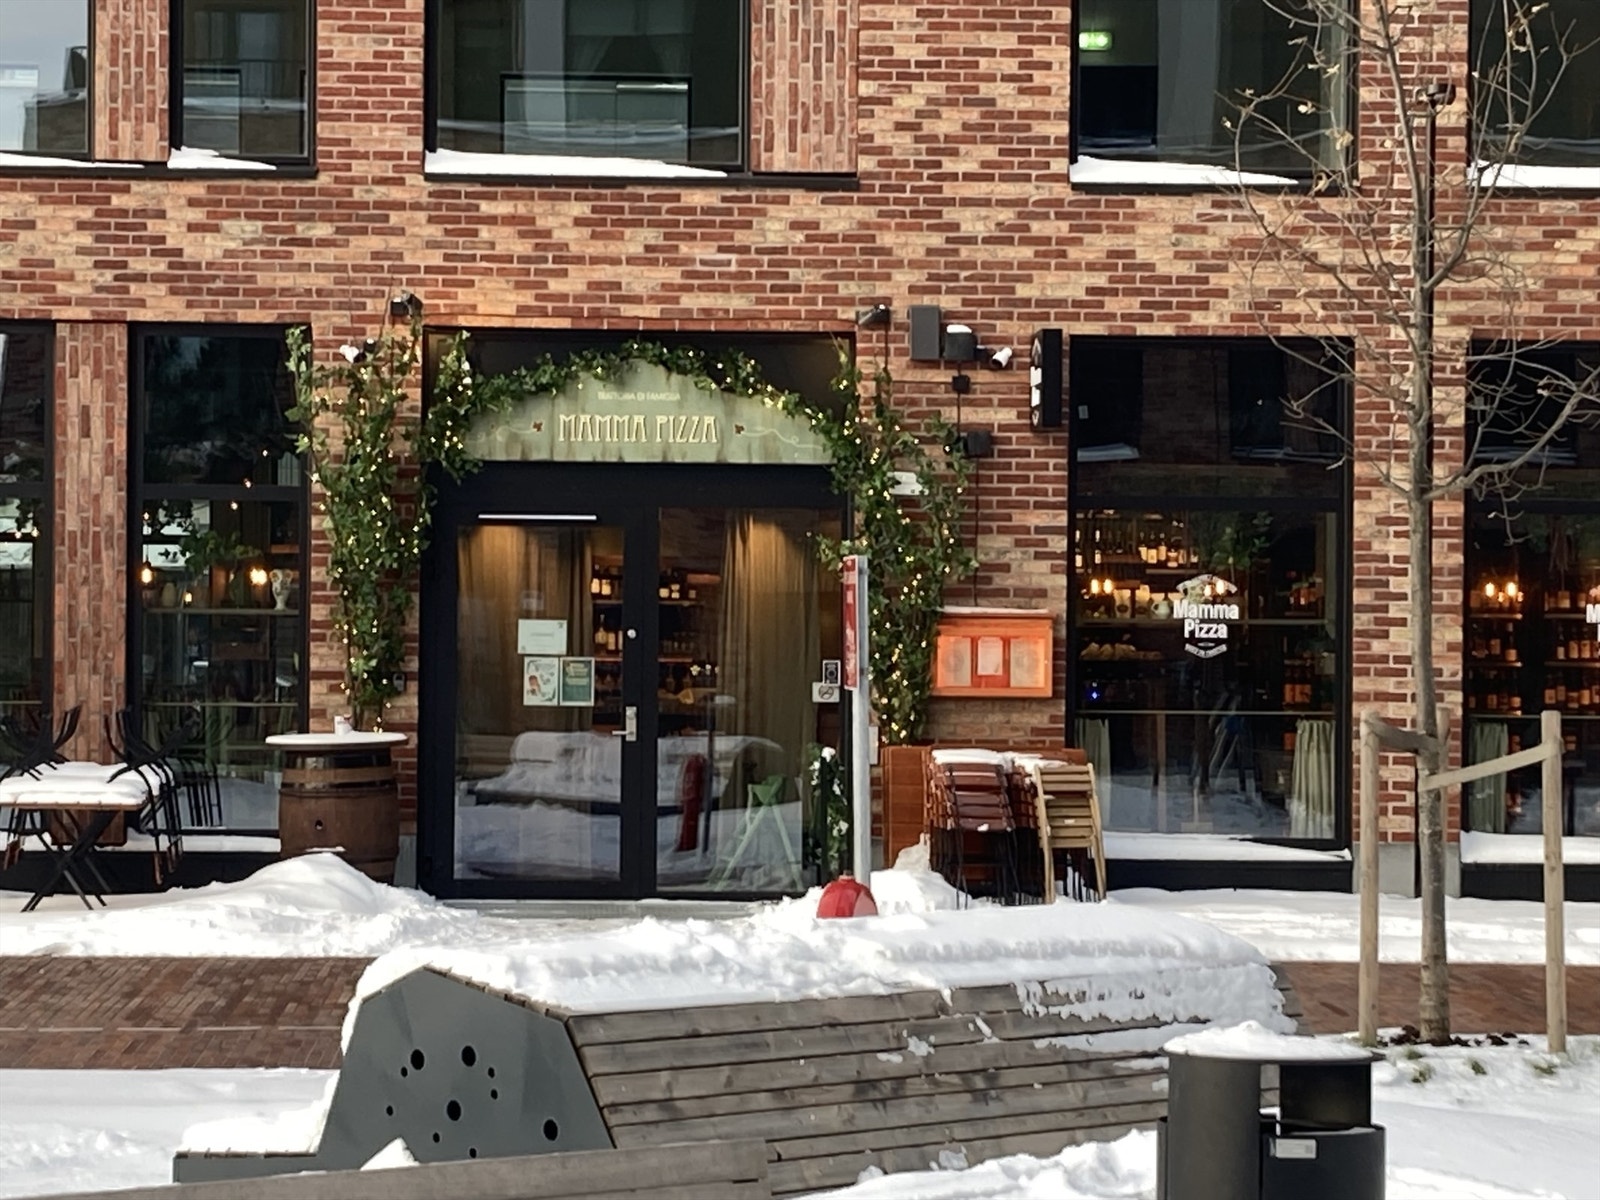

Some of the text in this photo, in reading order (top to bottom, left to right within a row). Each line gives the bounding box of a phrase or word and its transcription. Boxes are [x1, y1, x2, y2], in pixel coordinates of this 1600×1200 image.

[558, 413, 718, 443] MAMMA PIZZA
[1173, 599, 1239, 619] Mamma
[1184, 619, 1228, 638] Pizza
